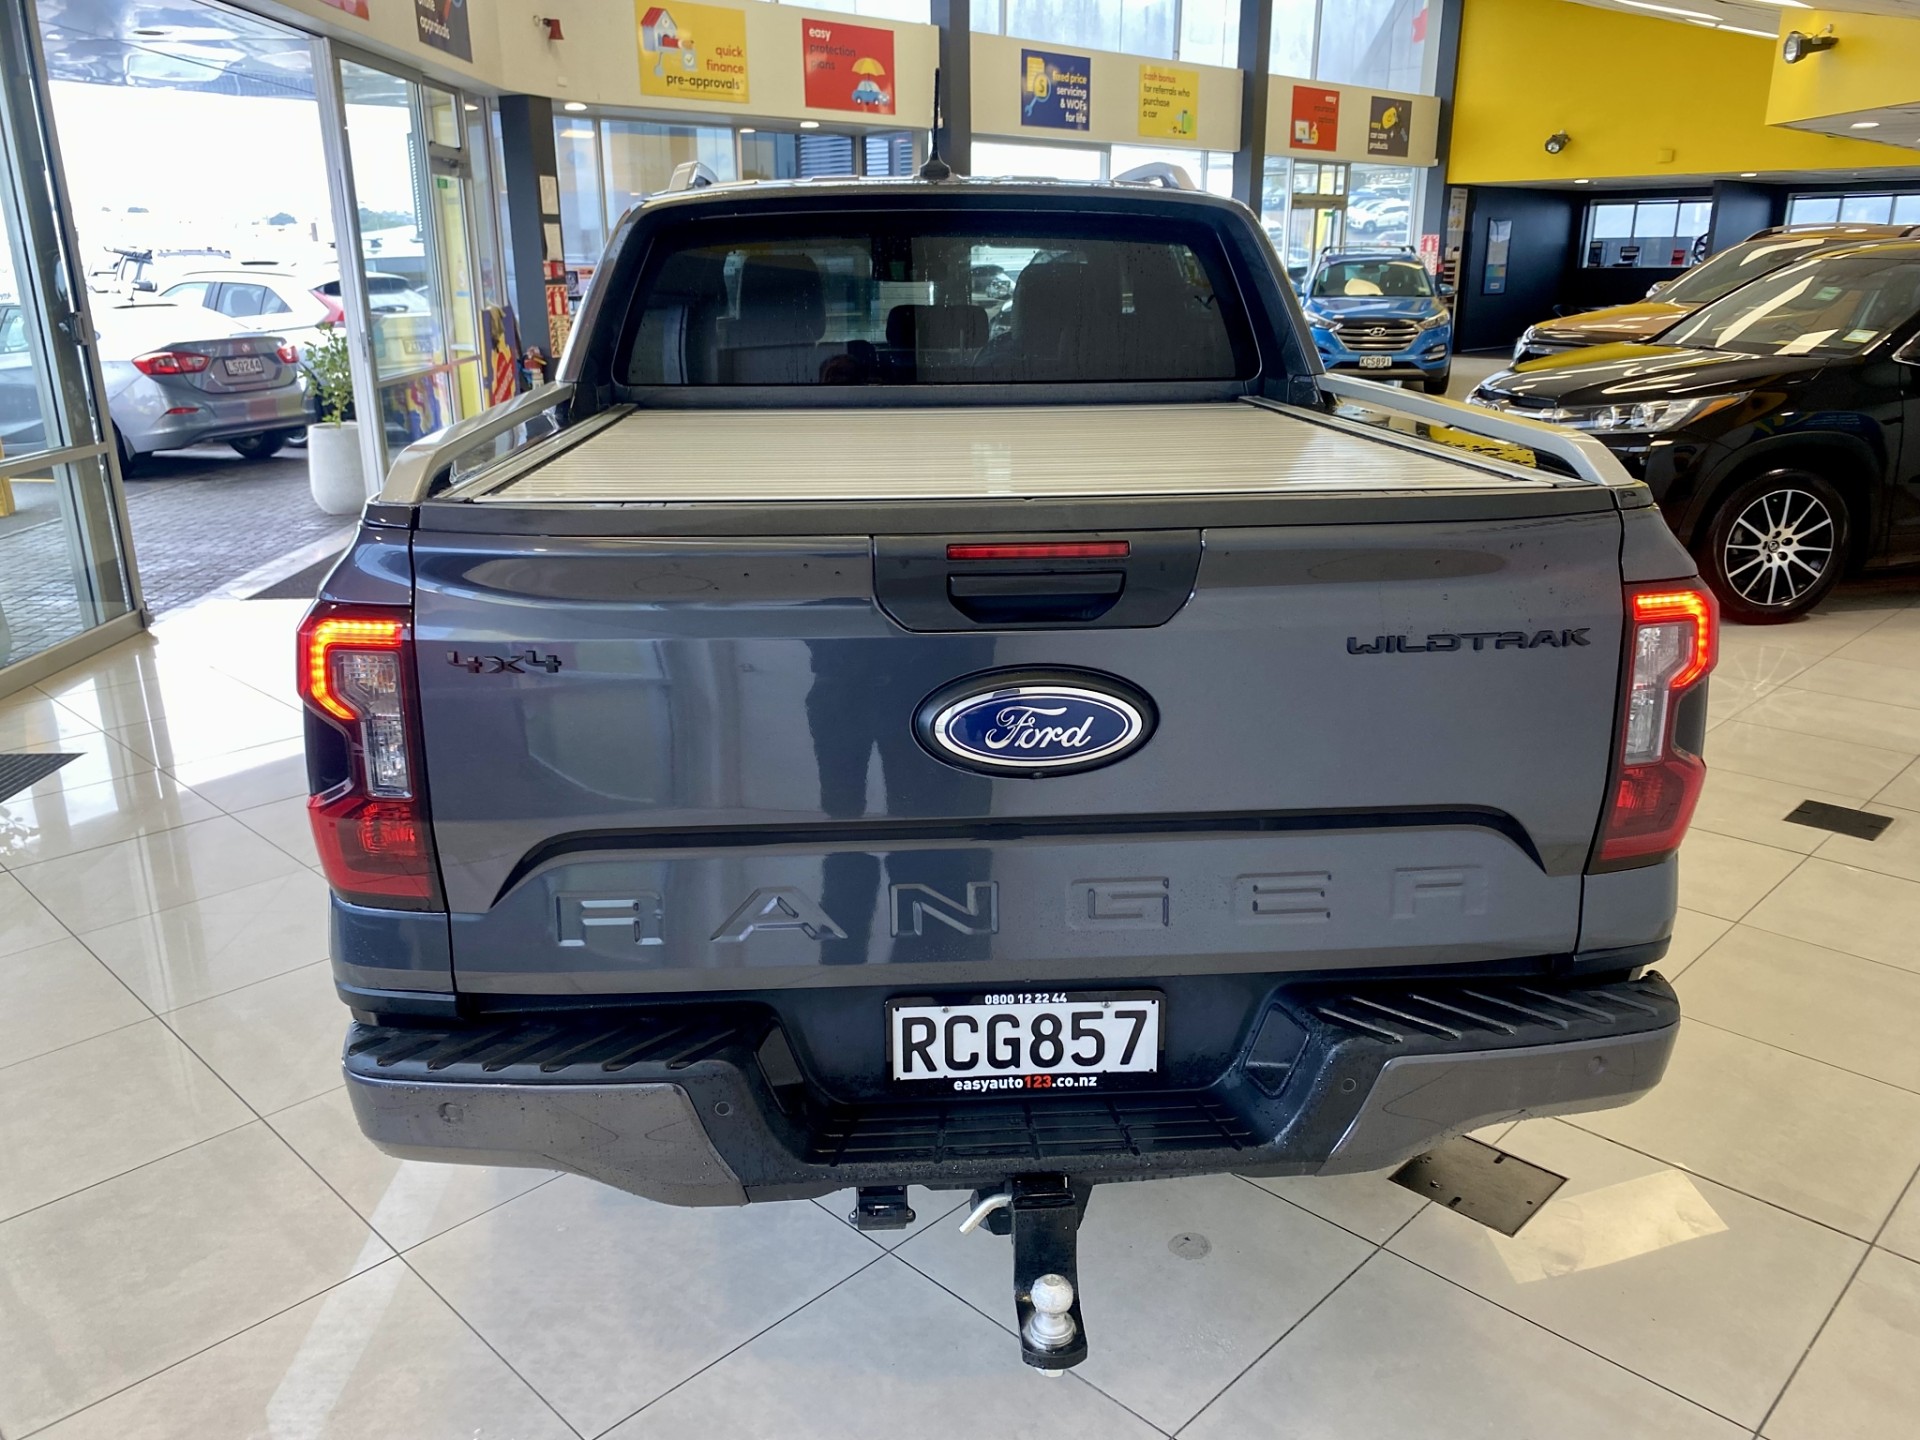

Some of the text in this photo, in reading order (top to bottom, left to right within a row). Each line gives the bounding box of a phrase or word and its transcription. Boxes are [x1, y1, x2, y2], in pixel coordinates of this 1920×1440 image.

[808, 28, 831, 41] easy
[715, 45, 743, 58] quick
[809, 44, 856, 57] protection
[706, 60, 744, 73] finance
[811, 60, 836, 71] plans
[1052, 71, 1087, 84] fixed price
[1057, 86, 1087, 99] servicing
[1060, 98, 1066, 108] &
[1143, 97, 1170, 107] purchase
[1065, 111, 1086, 123] for life
[1346, 627, 1592, 655] WILDTRAK
[985, 706, 1094, 749] Ford
[555, 865, 1488, 947] RANGER
[984, 993, 1068, 1005] 0800 12 22 44
[902, 1009, 1148, 1073] RCG857
[953, 1075, 1098, 1092] easyauto123.co.nz
